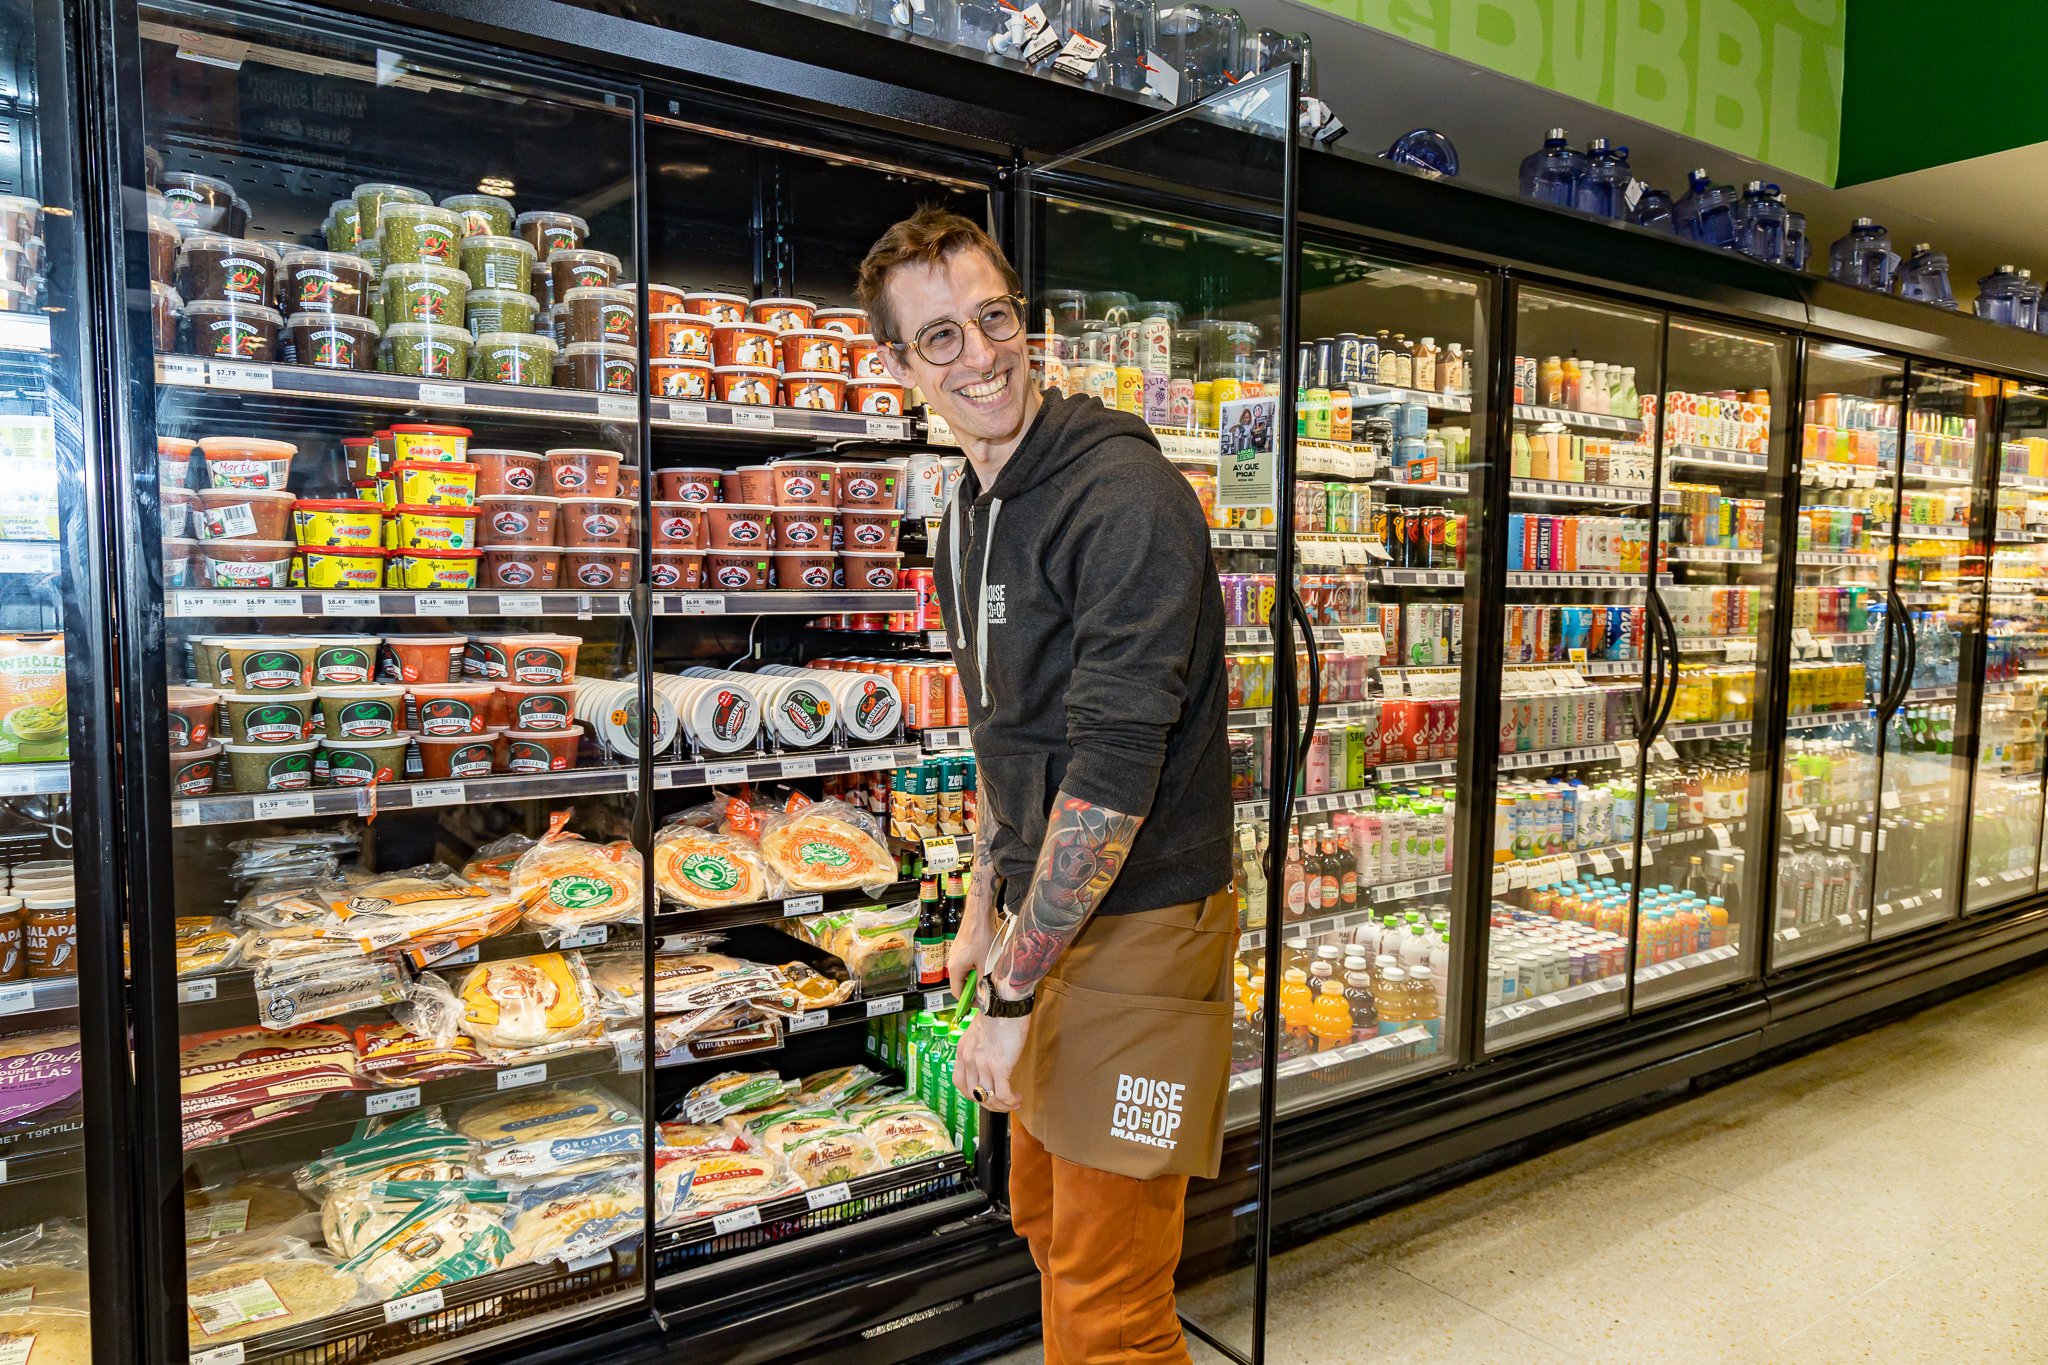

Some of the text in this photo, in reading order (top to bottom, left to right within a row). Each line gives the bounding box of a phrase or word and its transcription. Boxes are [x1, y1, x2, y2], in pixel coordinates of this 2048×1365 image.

[216, 369, 237, 377] $7.79
[552, 457, 591, 466] AMIGOS
[218, 462, 260, 473] Marti's
[781, 470, 819, 479] AMIGOS
[846, 471, 883, 480] AMIGOS
[676, 476, 712, 484] AMIGOS
[490, 504, 533, 513] AMIGOS
[580, 507, 622, 515] AMIGOS
[658, 510, 697, 518] AMIGOS
[726, 513, 765, 521] AMIGOS
[783, 515, 821, 523] AMIGOS
[852, 517, 888, 525] AMIGOS
[336, 528, 372, 536] SMOKED
[418, 528, 452, 537] SMOKED
[1540, 527, 1550, 559] ODYSSEY
[494, 554, 538, 563] AMIGOS
[574, 556, 617, 564] AMIGOS
[800, 560, 833, 568] AMIGOS
[223, 565, 265, 575] Marti's
[346, 571, 377, 580] SMOKED
[438, 573, 469, 581] SMOKED
[987, 585, 1005, 601] OISE
[267, 671, 297, 679] TOMATILLO
[16, 679, 53, 691] CLASSIC
[726, 703, 742, 737] CHIPOTLE
[789, 702, 814, 731] AVOCADO
[1587, 702, 1596, 739] ARDOR
[270, 724, 300, 732] TOMATILLO
[362, 720, 391, 728] TOMATILLO
[339, 769, 369, 777] TOMATILLO
[259, 801, 278, 809] $5.99
[926, 839, 954, 847] SALE
[399, 887, 473, 901] ORGANIC
[27, 924, 77, 937] JALAPA
[27, 936, 48, 949] JAR
[298, 978, 372, 1002] Handmade Style
[347, 998, 375, 1009] TORTILLAS
[696, 1040, 726, 1050] WHOLE
[259, 1043, 354, 1062] RICARDO'S
[8, 1056, 27, 1070] &
[223, 1060, 321, 1078] WHITE FLOUR
[502, 1074, 517, 1082] $7.79
[1116, 1074, 1186, 1112] BOISE
[181, 1096, 237, 1115] RICARDO'S
[279, 1094, 314, 1108] TORTILLAS
[371, 1098, 388, 1107] $4.99
[794, 1124, 821, 1132] Rancho
[886, 1127, 897, 1135] Mi
[563, 1134, 622, 1150] ORGANIC
[1110, 1127, 1177, 1150] MARKET
[808, 1145, 852, 1165] Mi Rancho
[695, 1169, 753, 1182] ORGANIC
[390, 1302, 408, 1311] $4.99
